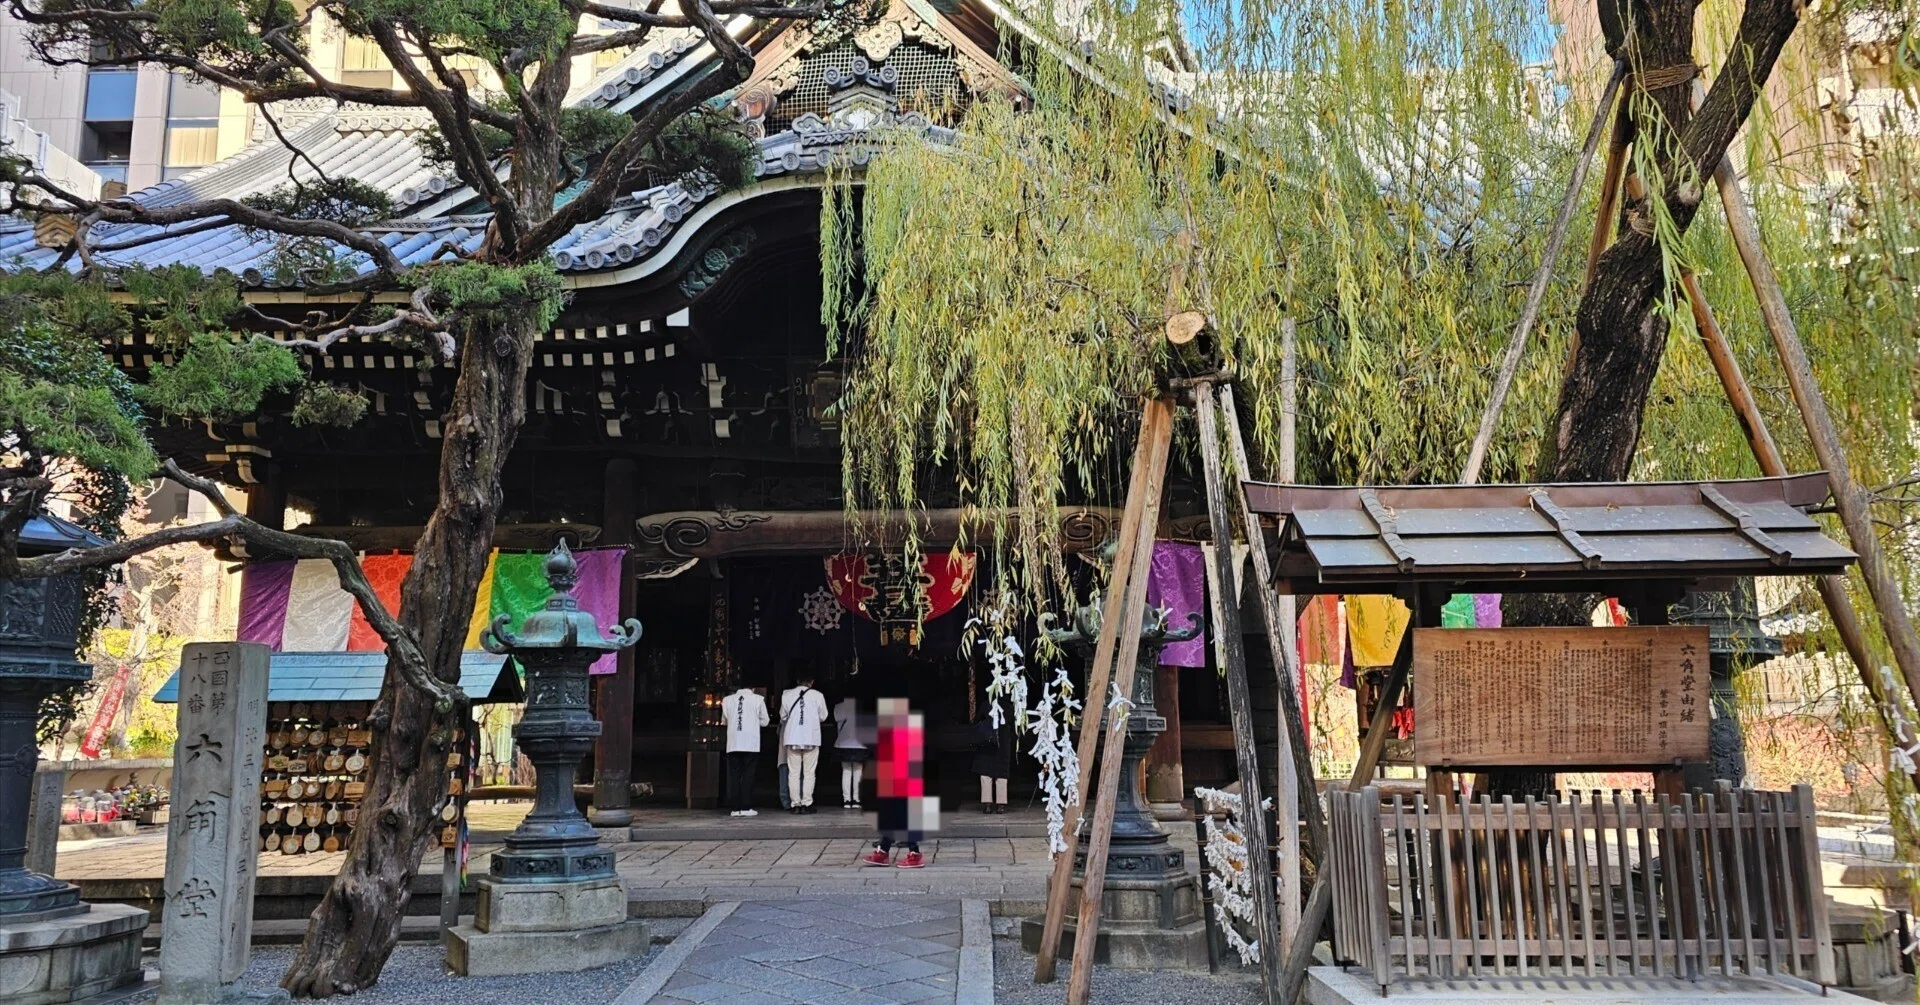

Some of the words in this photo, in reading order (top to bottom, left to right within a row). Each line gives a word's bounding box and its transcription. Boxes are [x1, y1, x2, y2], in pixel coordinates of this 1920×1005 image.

[187, 652, 208, 715] 十八番
[1680, 644, 1696, 723] 六角堂由緒
[178, 733, 223, 919] 六角堂
